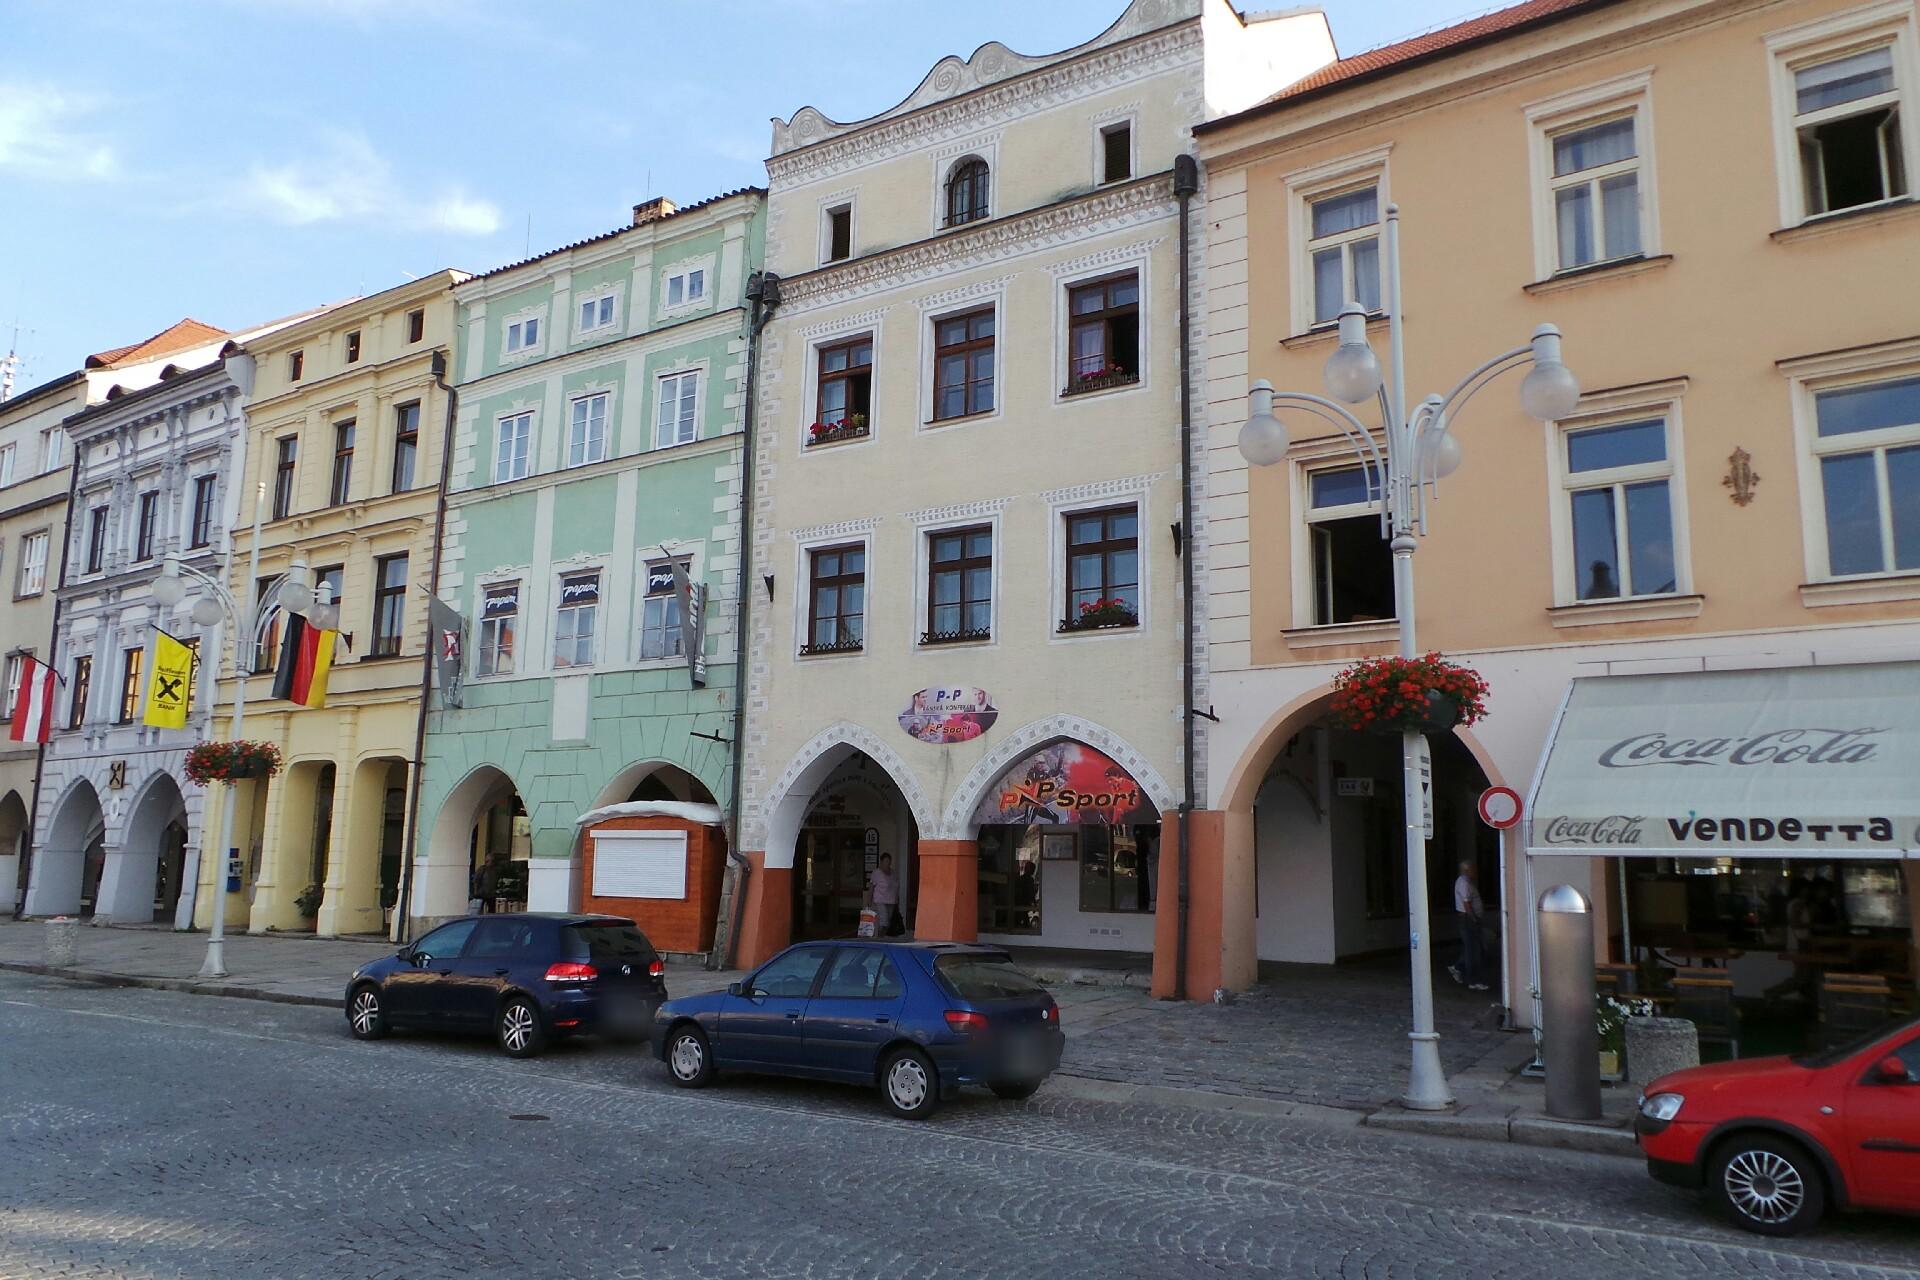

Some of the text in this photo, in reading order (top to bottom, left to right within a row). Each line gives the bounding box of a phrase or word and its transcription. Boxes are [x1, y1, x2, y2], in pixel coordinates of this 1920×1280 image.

[1598, 727, 1893, 768] Coca-Cola
[1056, 789, 1137, 810] Sport
[1544, 815, 1648, 844] Coca-Cola
